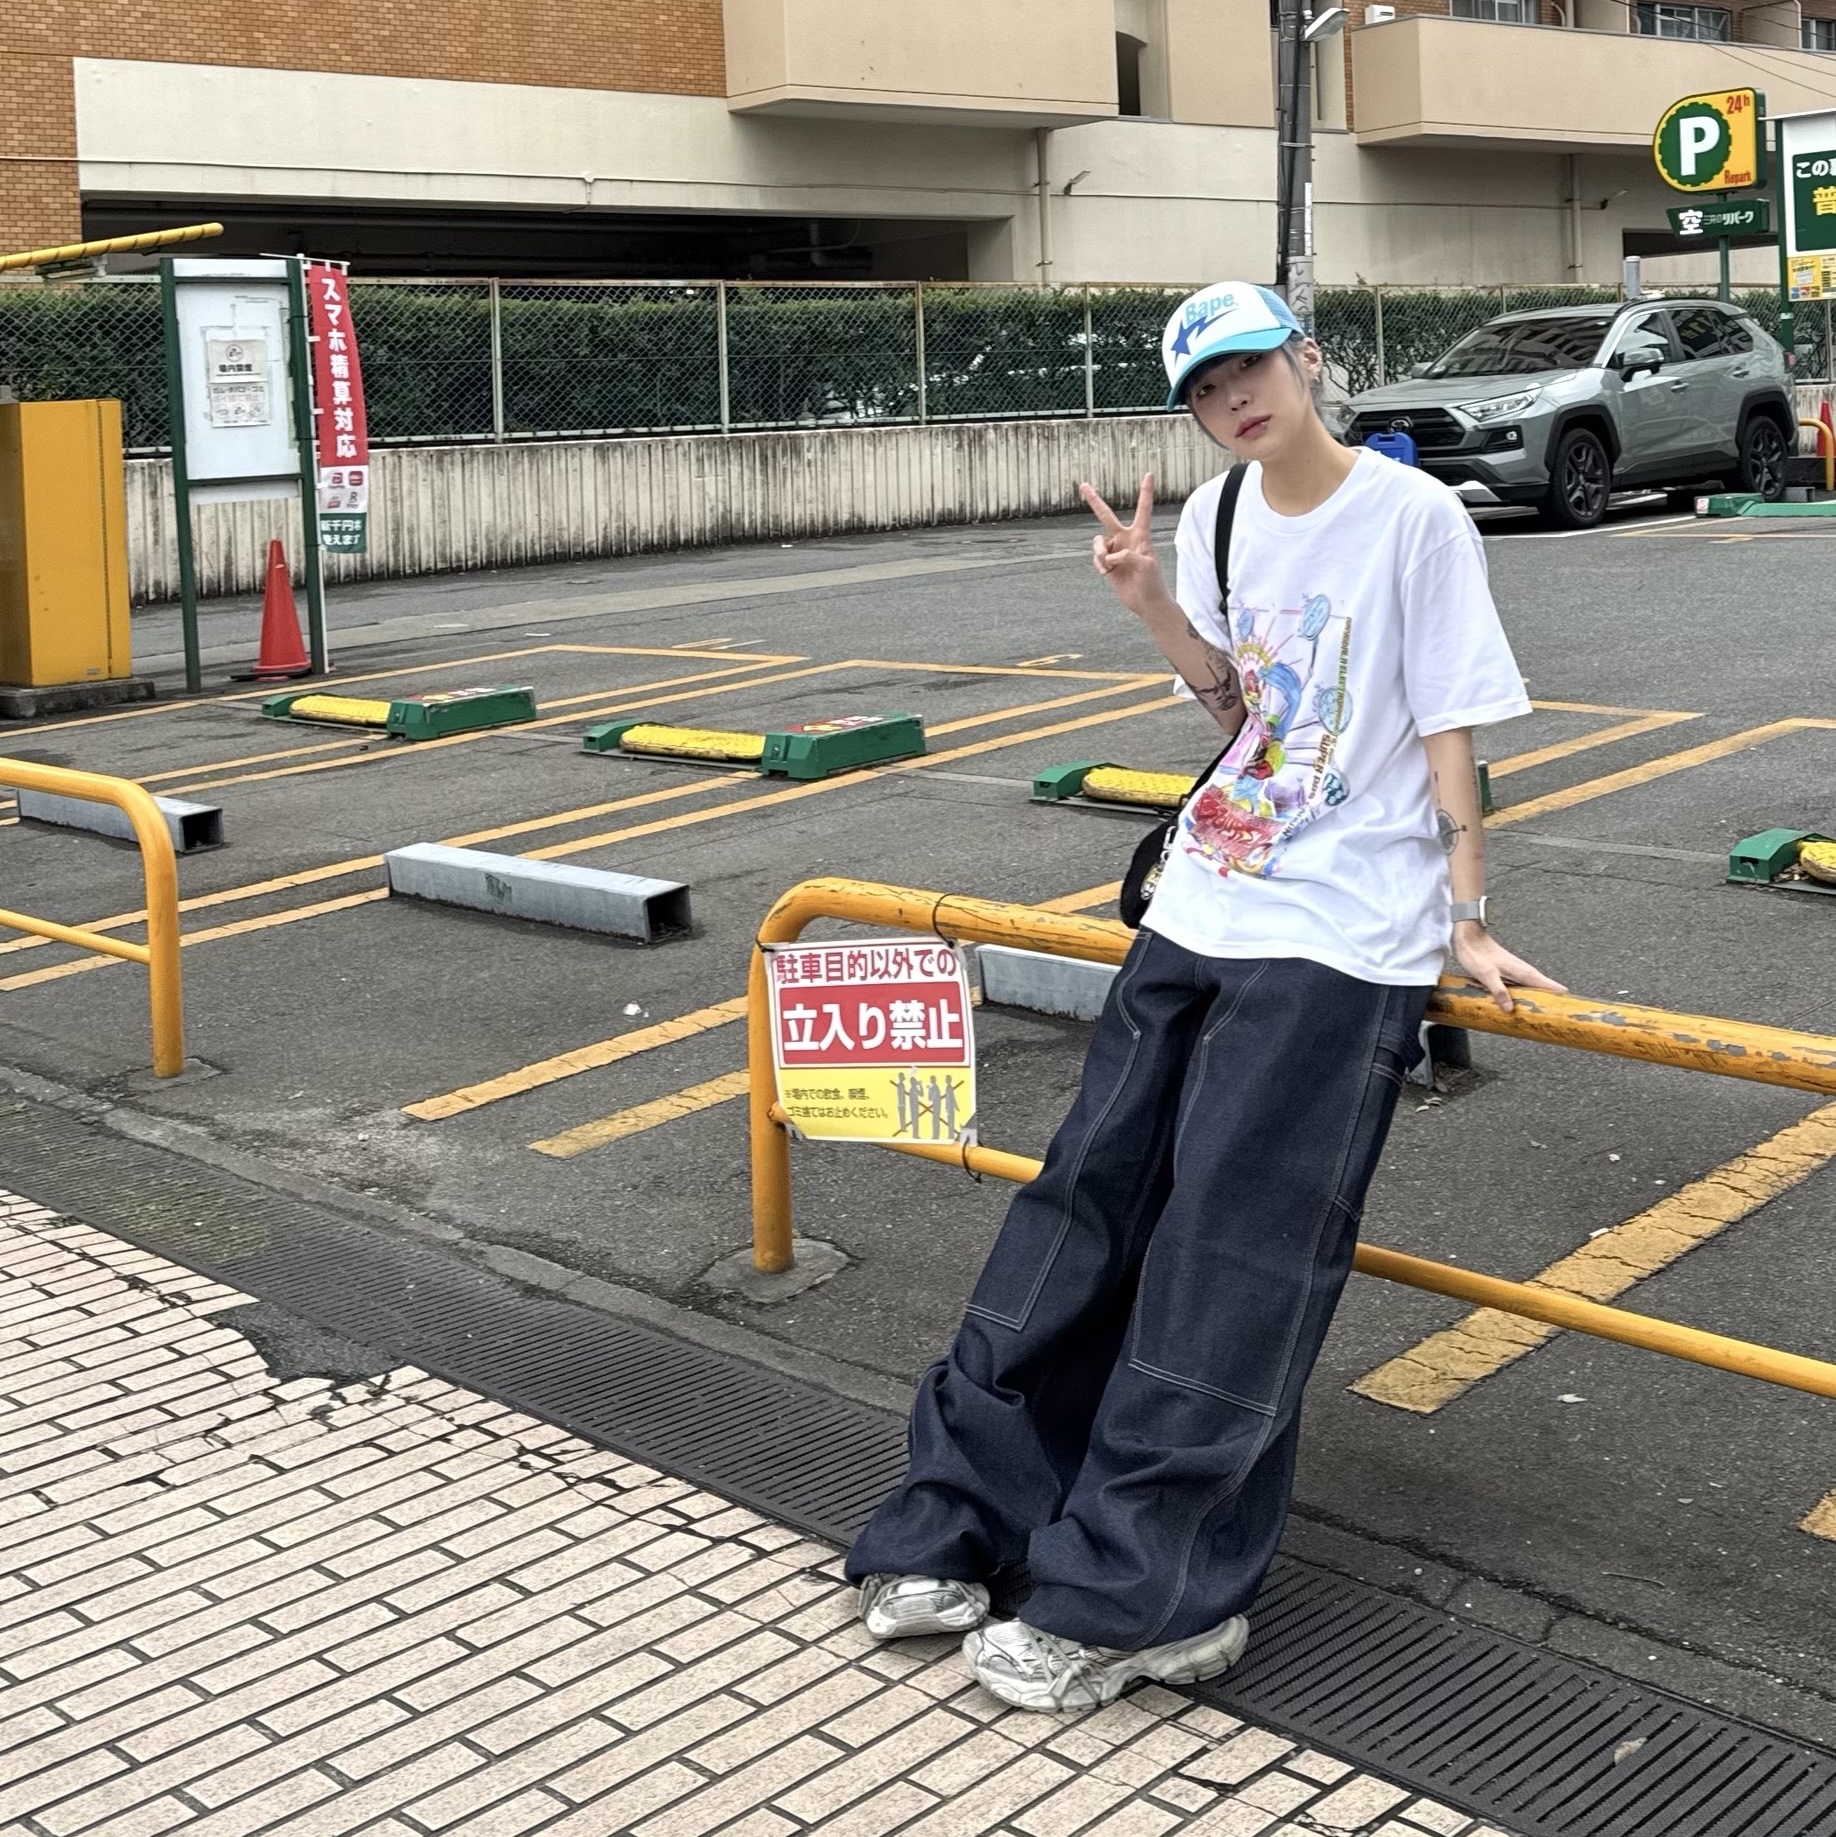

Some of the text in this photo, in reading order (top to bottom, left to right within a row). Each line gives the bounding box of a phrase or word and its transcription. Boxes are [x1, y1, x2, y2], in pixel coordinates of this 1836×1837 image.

[1679, 116, 1720, 176] P
[1724, 170, 1752, 184] Repark
[1679, 209, 1704, 235] 空
[1186, 293, 1235, 327] Bape
[321, 277, 358, 458] スマホ精算対応
[776, 948, 956, 984] 駐車目的以外での
[782, 998, 963, 1051] 立入り禁止
